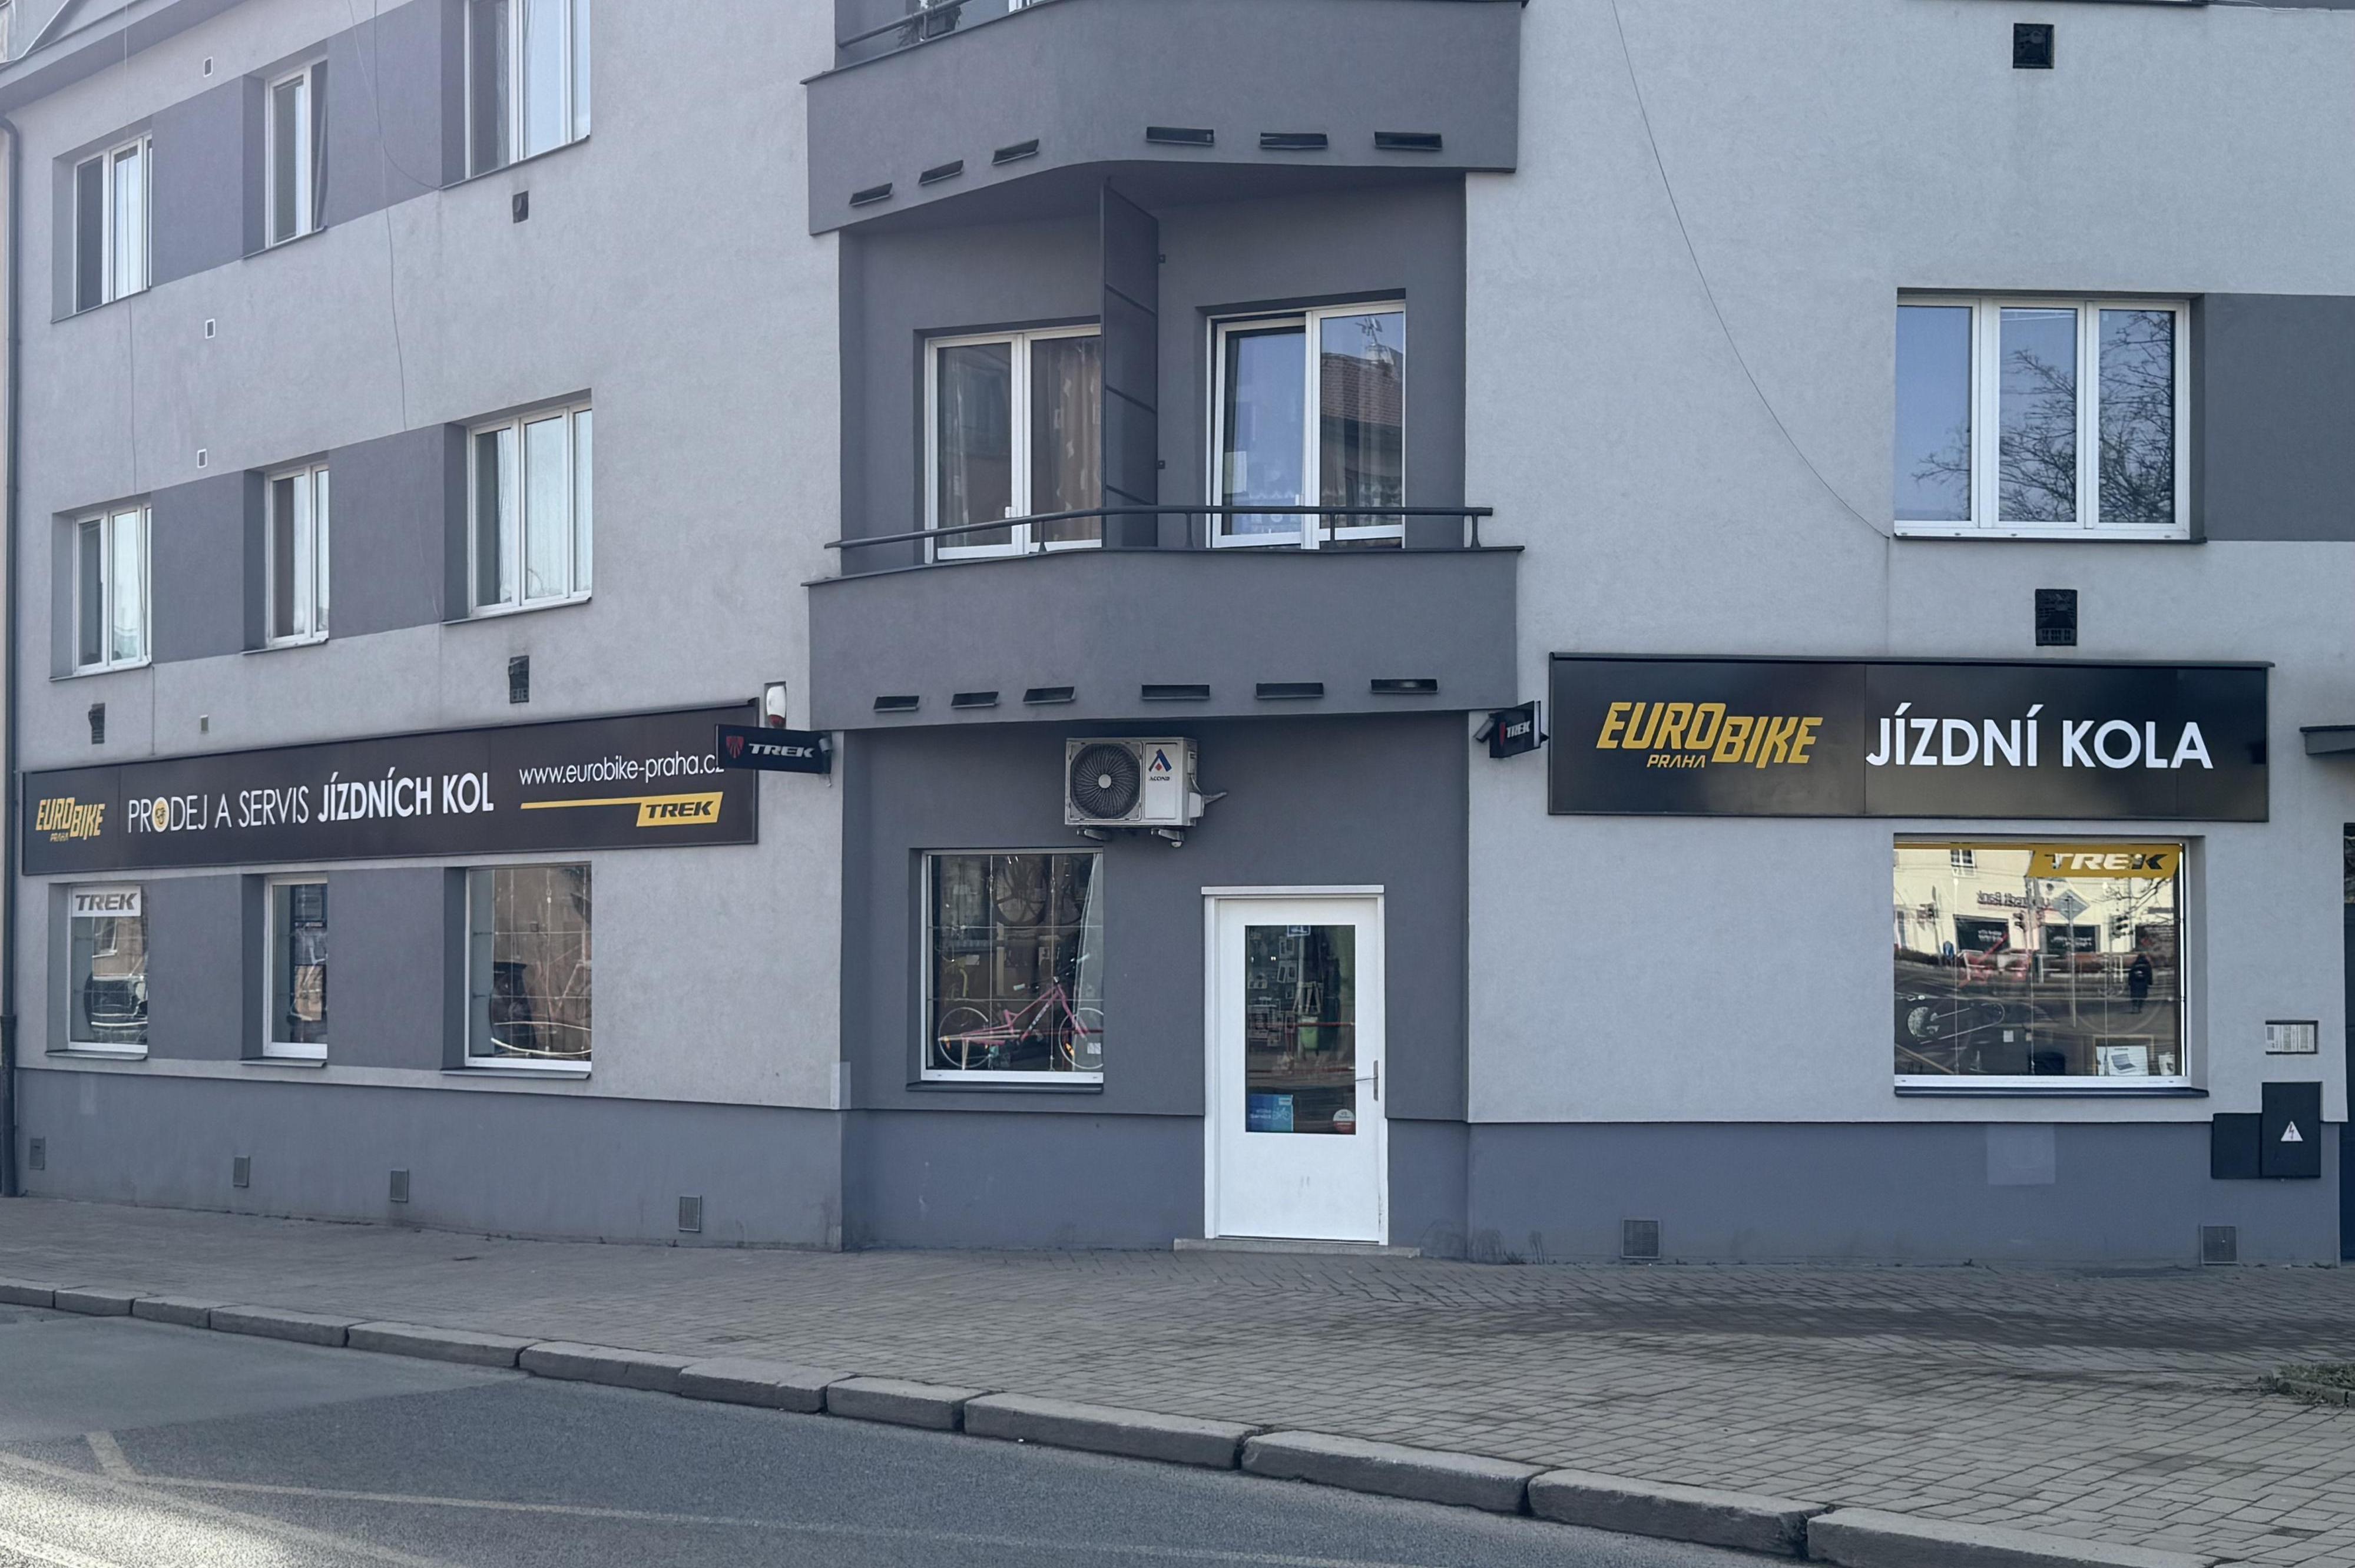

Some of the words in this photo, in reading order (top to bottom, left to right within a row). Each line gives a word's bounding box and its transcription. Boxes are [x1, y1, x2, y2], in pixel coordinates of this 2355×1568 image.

[1506, 720, 1531, 738] TREK
[1866, 702, 2043, 766] JÍZDNÍ
[2062, 720, 2214, 769] KOLA
[749, 743, 816, 758] TREK
[1647, 754, 1706, 768] PRAHA
[128, 794, 207, 833] PRODEJ
[214, 794, 232, 828] A
[238, 785, 309, 827] SERVIS
[317, 767, 432, 823] JÍZDNÍCH
[443, 772, 494, 814] KOL
[646, 800, 714, 818] TREK
[2044, 854, 2168, 870] TREK
[75, 893, 137, 911] TREK
